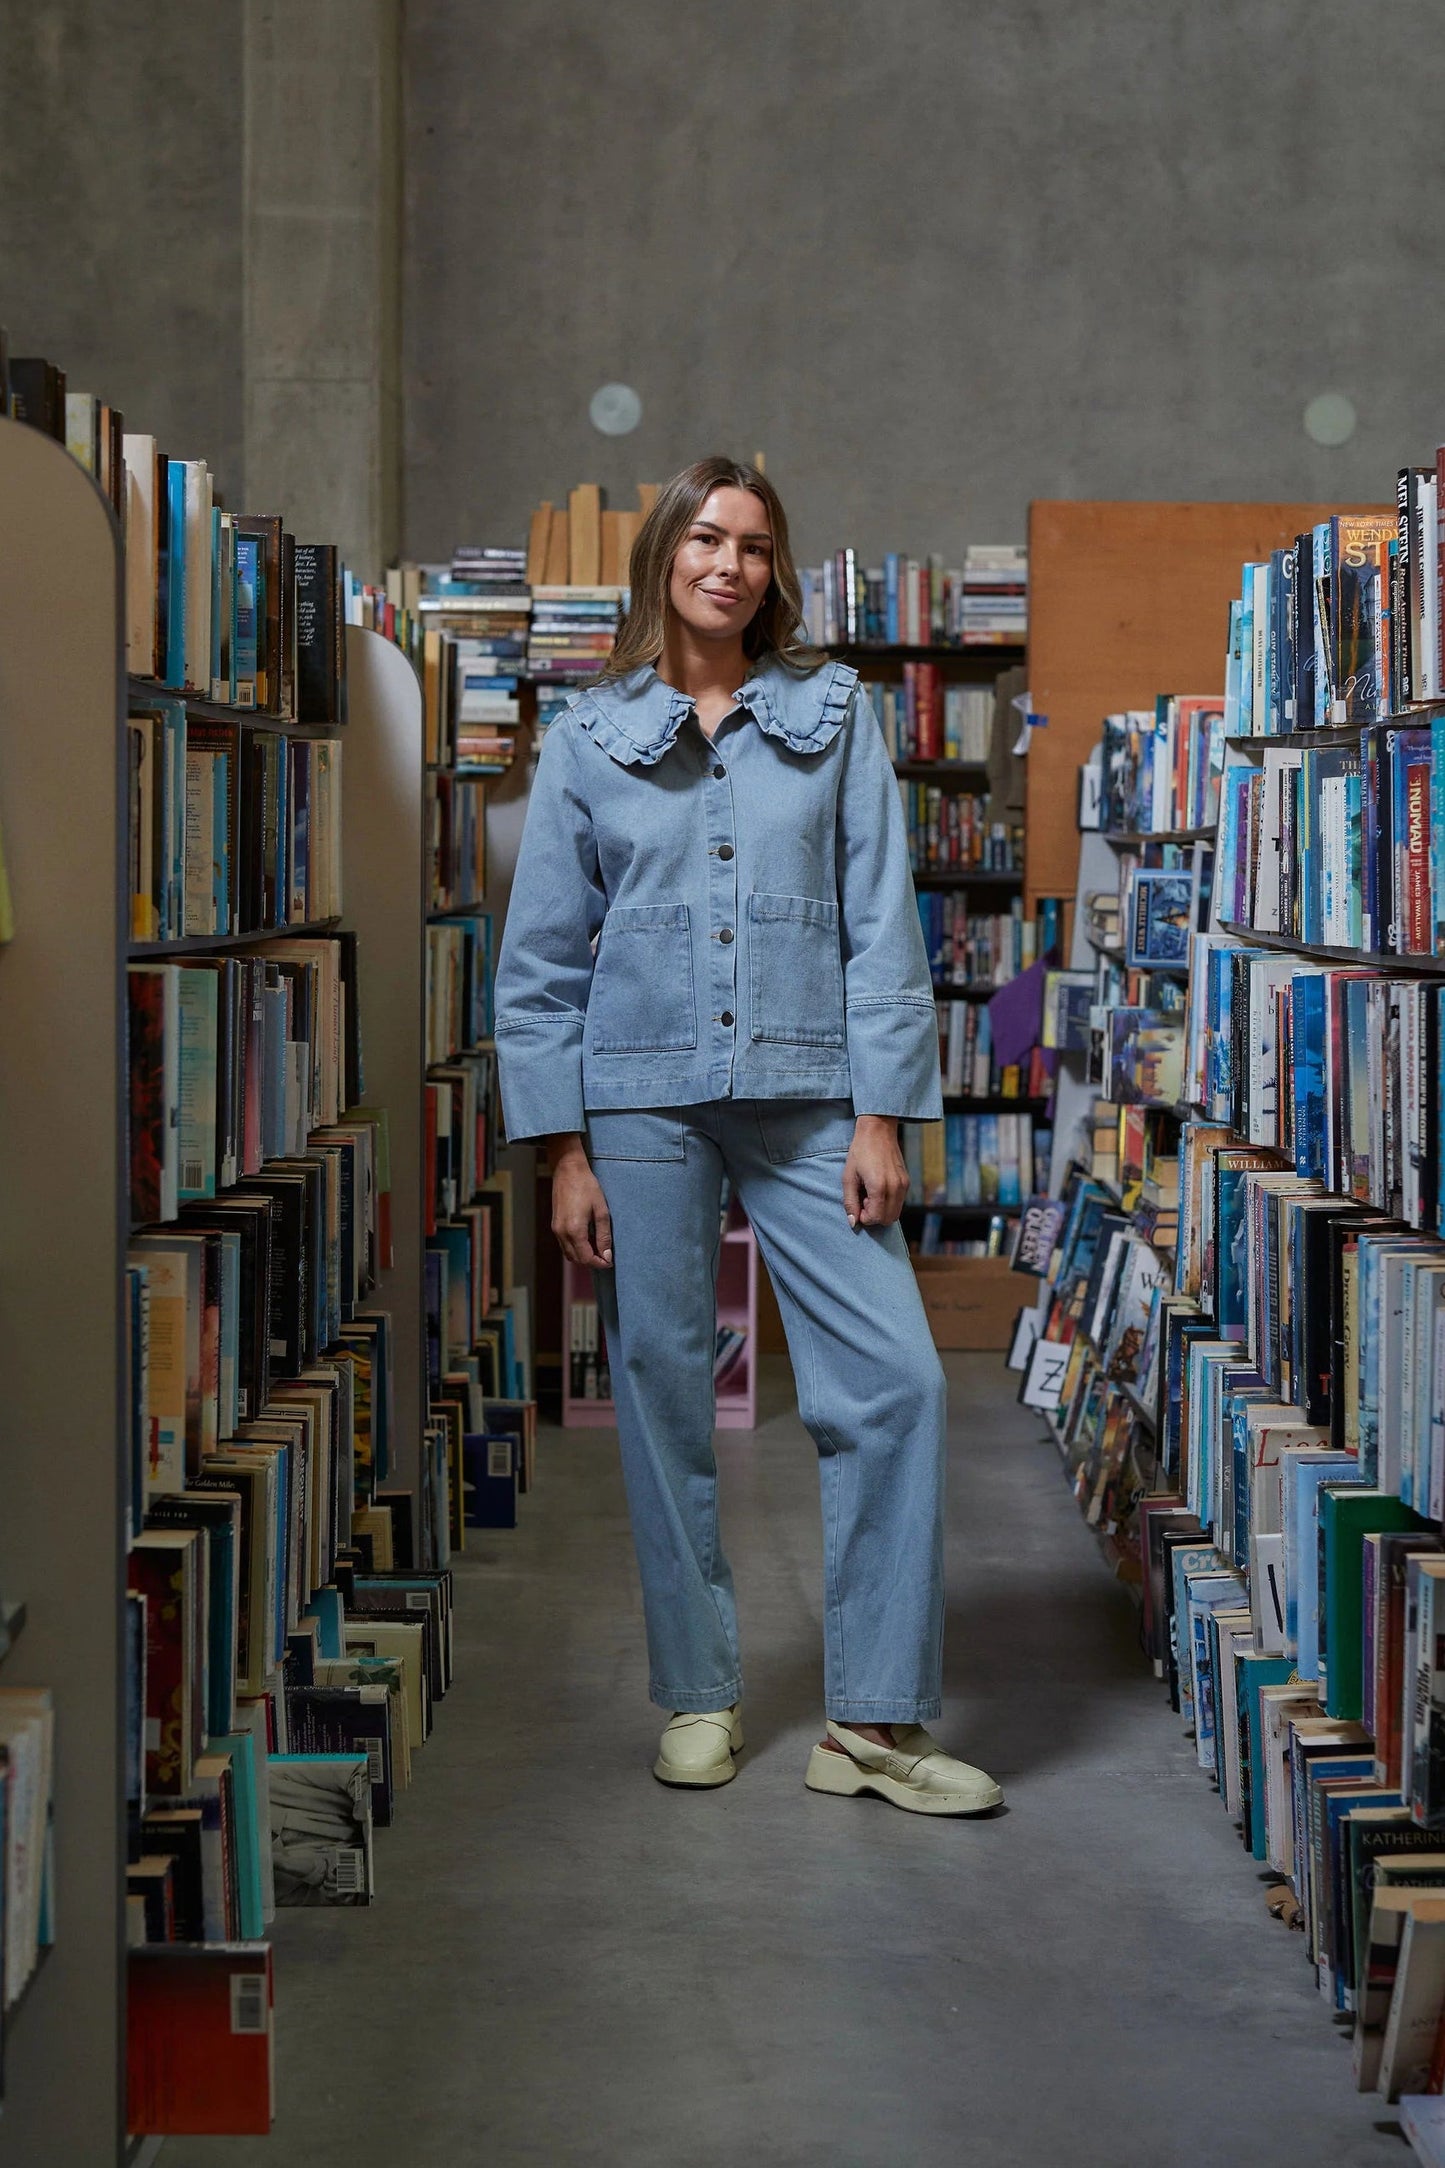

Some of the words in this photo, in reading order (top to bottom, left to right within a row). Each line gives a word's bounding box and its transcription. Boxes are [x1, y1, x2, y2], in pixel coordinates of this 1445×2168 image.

[1397, 474, 1409, 508] MEL
[1339, 520, 1355, 528] NEW
[1357, 520, 1373, 528] YORK
[1375, 520, 1393, 528] TIMES
[1399, 514, 1409, 564] STEIN
[1399, 567, 1407, 598] Race
[1409, 787, 1422, 854] NOMAD
[1137, 885, 1148, 927] MICHELLE
[1136, 927, 1147, 952] WEST
[1228, 1159, 1284, 1169] WILLIAM
[1184, 1181, 1192, 1223] SECOND
[1019, 1207, 1043, 1263] QUEEN
[1039, 1358, 1065, 1394] Z
[1223, 1464, 1231, 1492] VOIGT
[1362, 1832, 1445, 1845] KATHERINE
